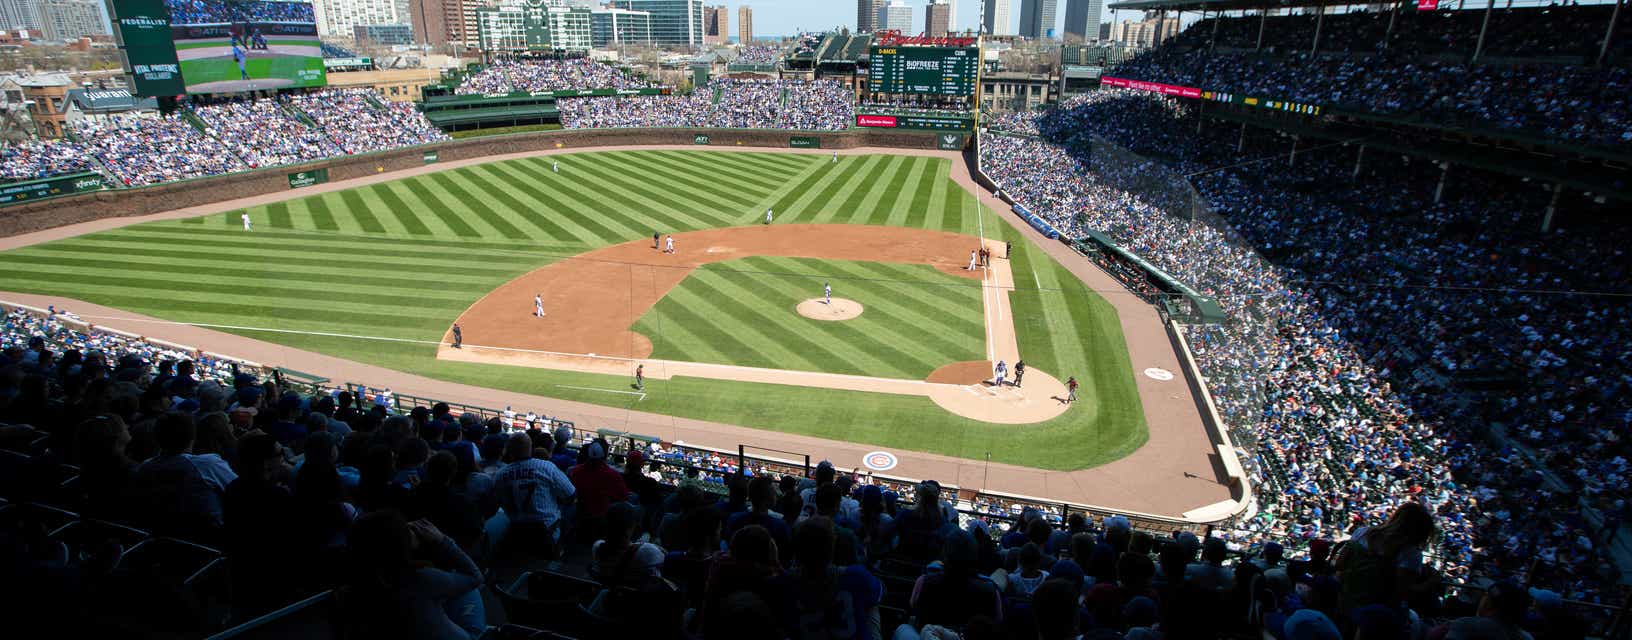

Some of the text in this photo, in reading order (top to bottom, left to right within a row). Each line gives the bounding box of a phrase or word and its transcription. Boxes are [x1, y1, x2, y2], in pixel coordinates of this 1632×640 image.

[120, 18, 167, 26] FEDERALIST
[875, 29, 974, 46] Budweiser
[75, 178, 101, 189] xfinity
